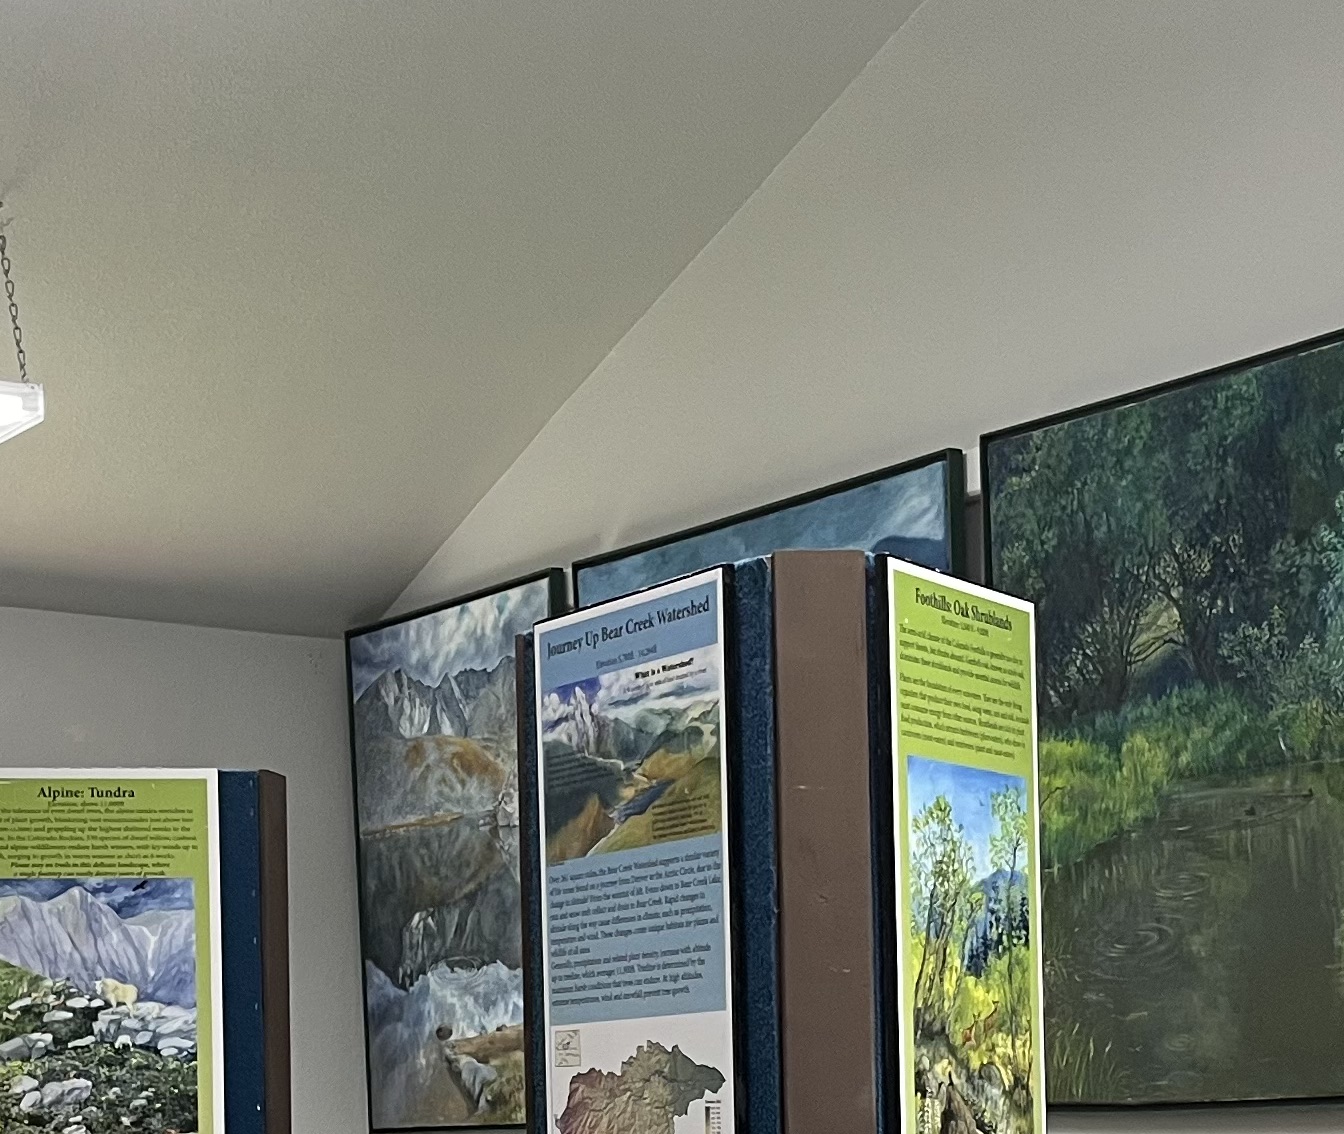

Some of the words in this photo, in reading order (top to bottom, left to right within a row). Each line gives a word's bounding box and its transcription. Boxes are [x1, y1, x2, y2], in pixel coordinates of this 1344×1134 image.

[547, 637, 582, 659] Journey
[584, 630, 599, 649] Up
[601, 625, 623, 641] Bear
[625, 612, 654, 634] Creek
[656, 595, 709, 623] Watershed
[953, 599, 969, 618] Oak
[971, 605, 1012, 630] Shrublands
[37, 786, 84, 801] Alpine:
[88, 786, 135, 798] Tundra
